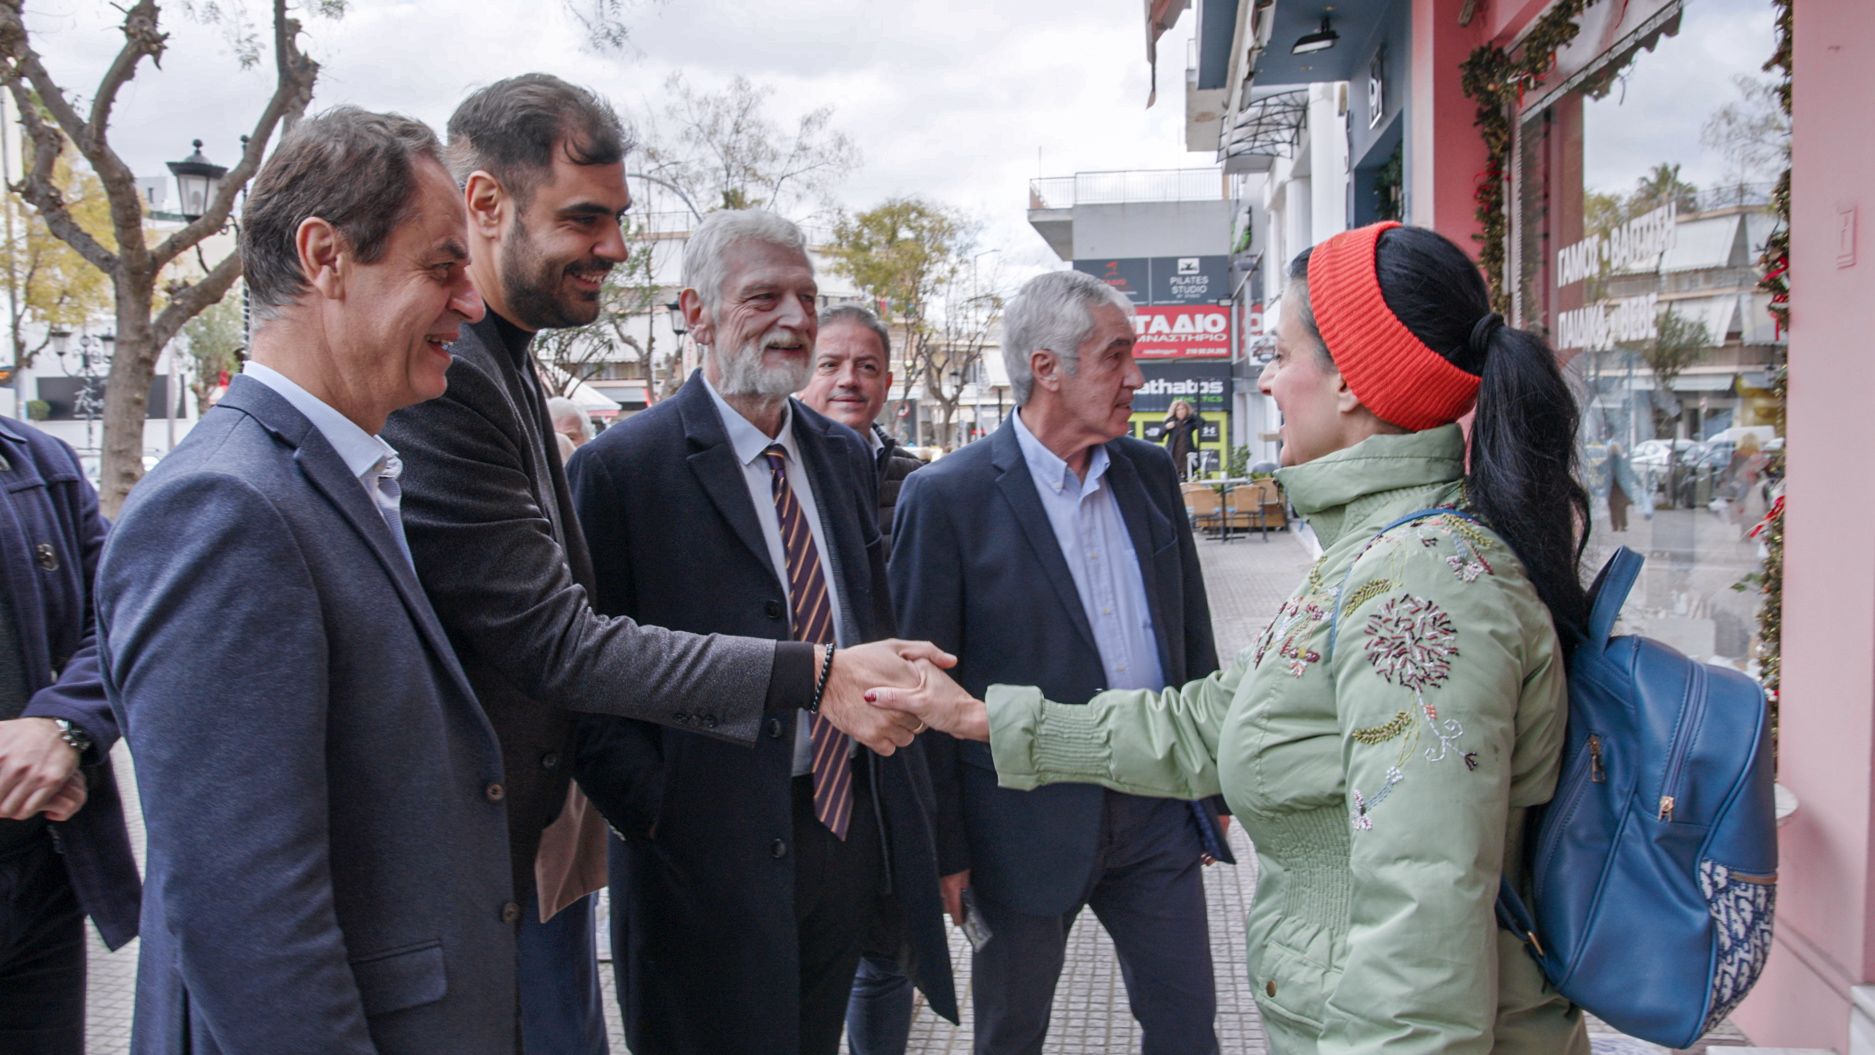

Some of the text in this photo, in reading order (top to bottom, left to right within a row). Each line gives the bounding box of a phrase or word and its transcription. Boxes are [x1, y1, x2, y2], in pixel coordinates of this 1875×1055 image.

[1557, 232, 1600, 289] ΓΑΜΟΣ
[1169, 275, 1209, 286] PILATES
[1171, 285, 1208, 295] STUDIO
[1127, 313, 1227, 334] ΤΑΔΙΟ
[1133, 378, 1224, 395] athatos
